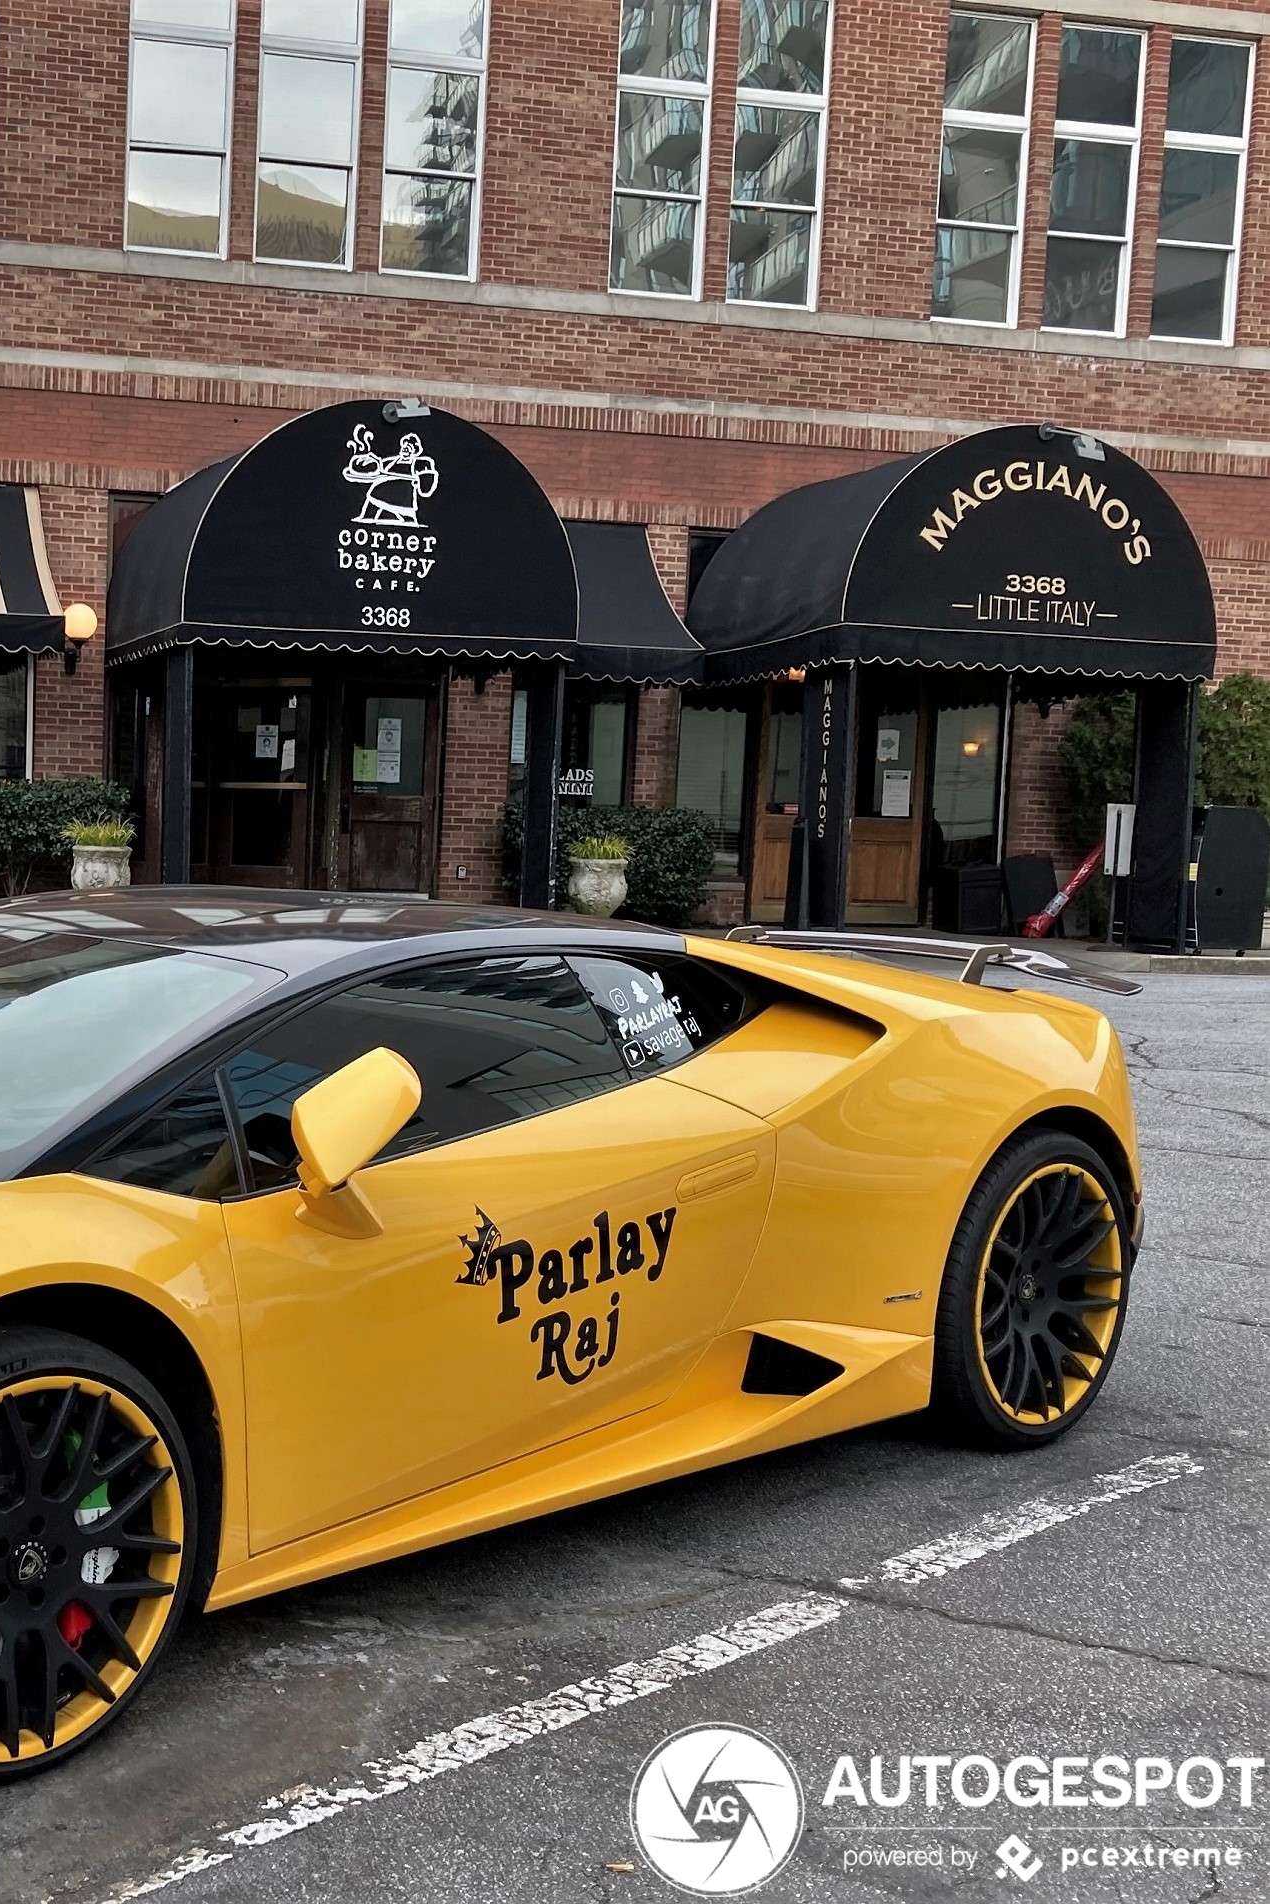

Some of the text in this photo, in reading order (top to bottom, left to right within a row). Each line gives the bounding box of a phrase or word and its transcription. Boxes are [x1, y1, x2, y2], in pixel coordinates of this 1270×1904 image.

[919, 461, 1152, 565] MAGGIANO'S
[338, 529, 437, 553] corner
[337, 548, 436, 578] bakery
[1005, 574, 1066, 595] 3368
[360, 606, 411, 628] 3368
[976, 592, 1096, 627] LITTLE ITALY
[559, 768, 594, 782] ADS
[617, 995, 682, 1040] PARLAYRAJ
[643, 1010, 702, 1056] savage raj
[487, 1206, 678, 1325] Parlay
[530, 1291, 622, 1385] Raj
